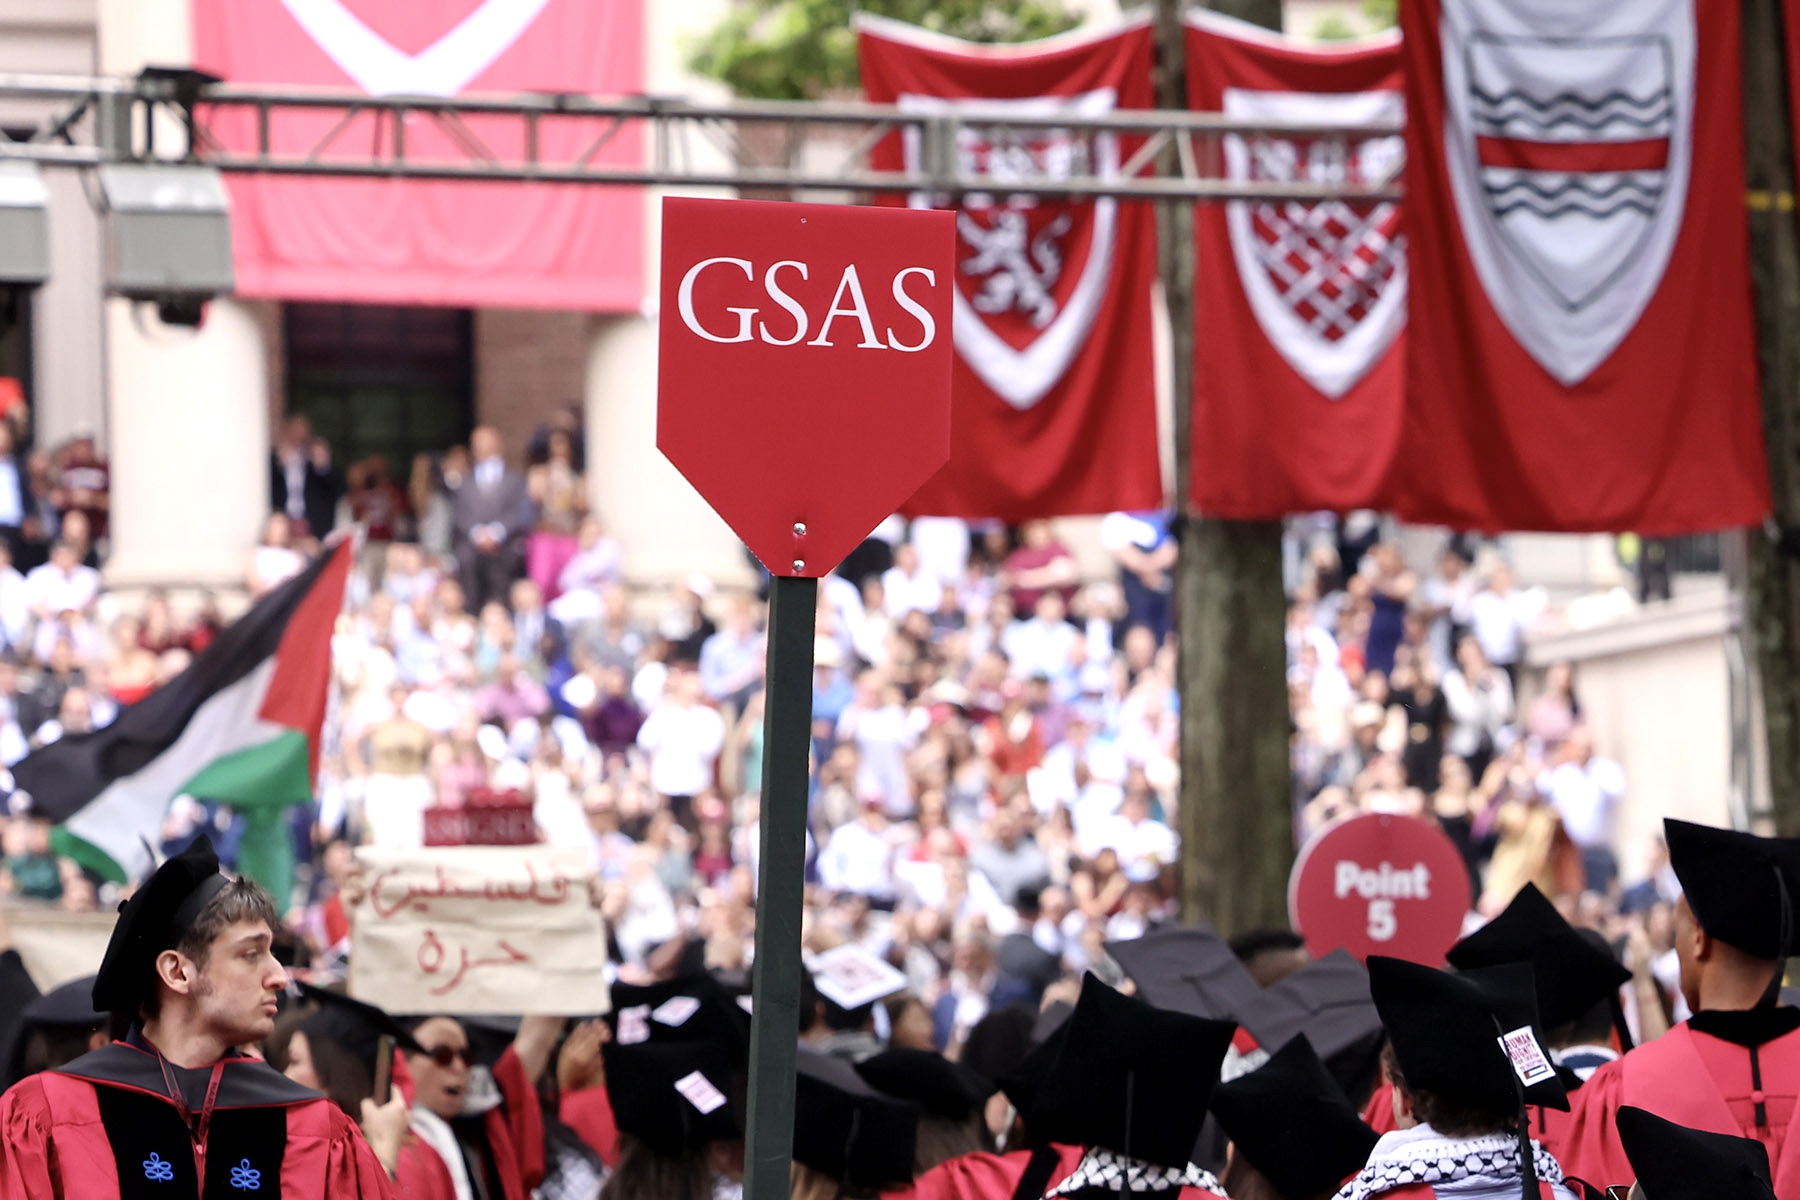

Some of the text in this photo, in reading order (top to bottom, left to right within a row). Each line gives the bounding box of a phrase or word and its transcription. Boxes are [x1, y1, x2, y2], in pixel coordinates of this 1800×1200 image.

[677, 256, 937, 353] GSAS
[371, 860, 572, 919] فلسطين
[1334, 860, 1432, 900] Point
[1366, 899, 1398, 942] 5
[417, 928, 531, 996] حرة
